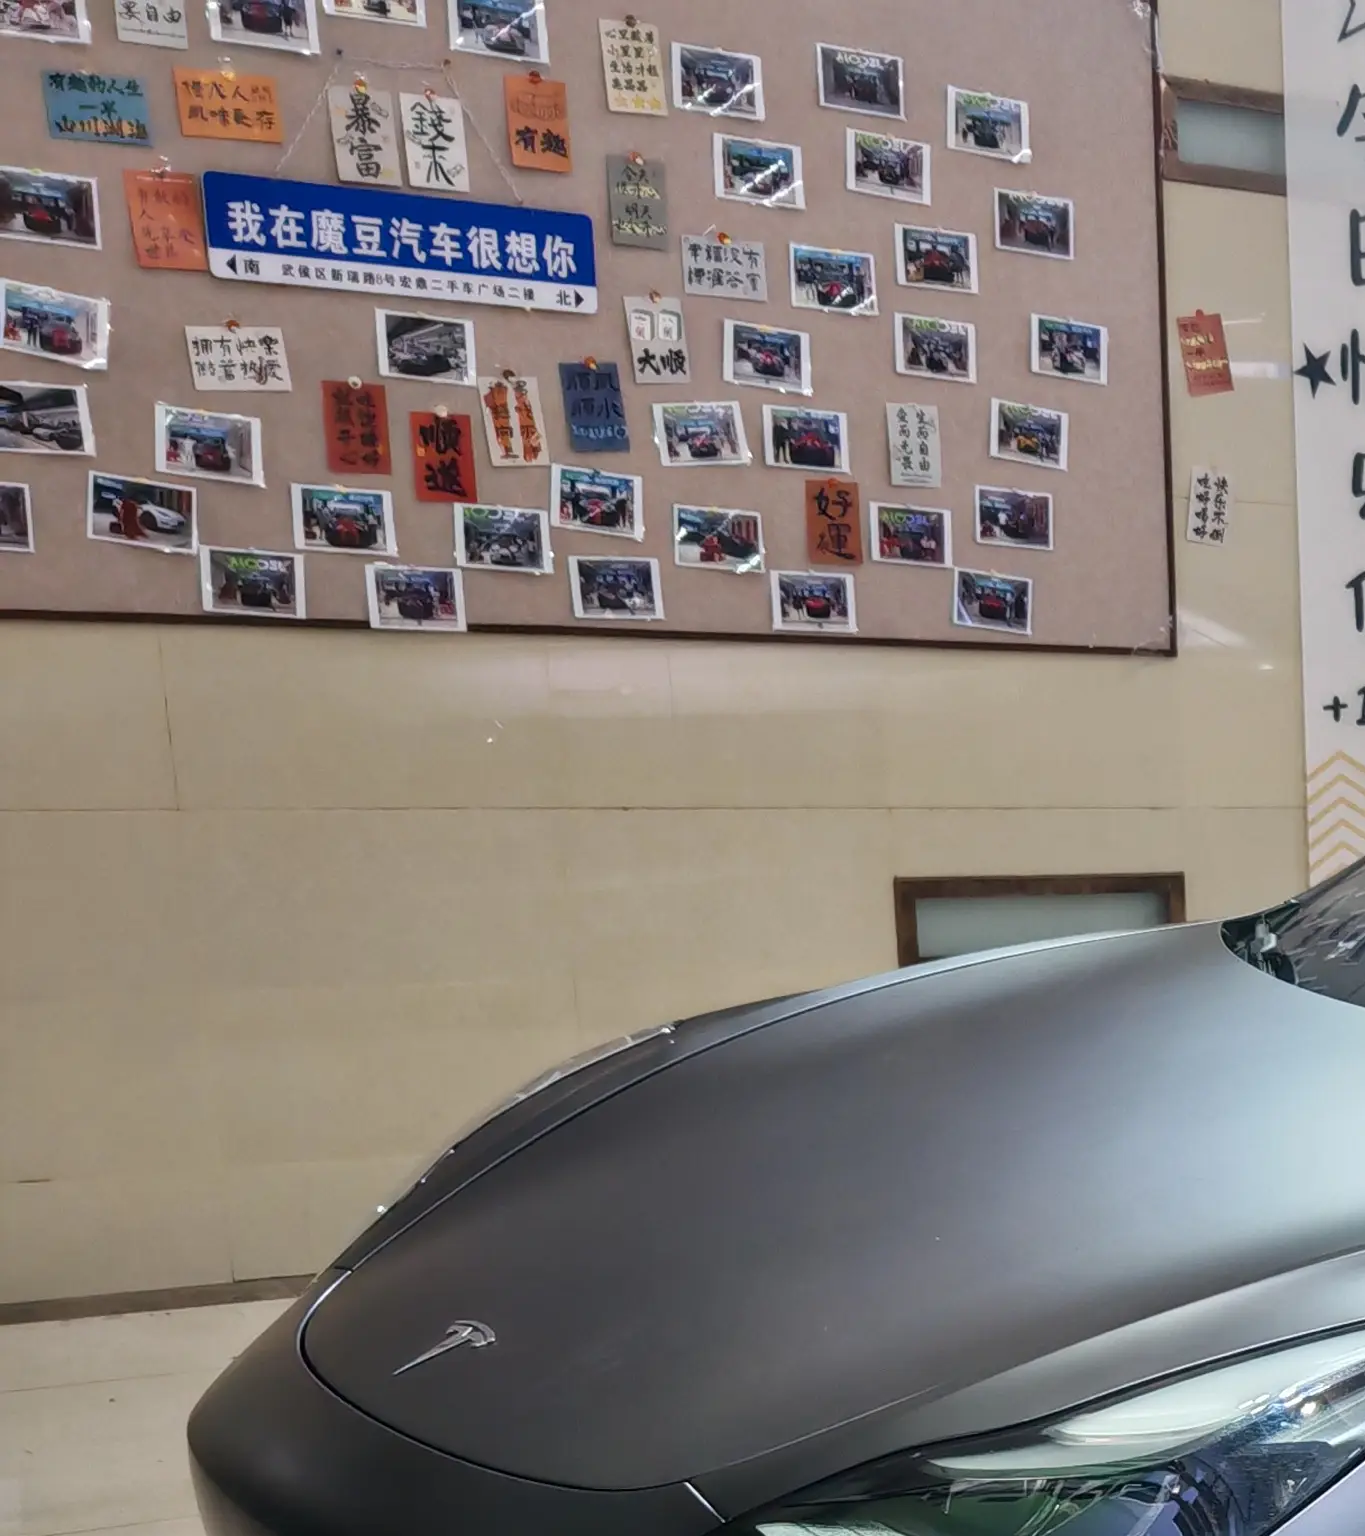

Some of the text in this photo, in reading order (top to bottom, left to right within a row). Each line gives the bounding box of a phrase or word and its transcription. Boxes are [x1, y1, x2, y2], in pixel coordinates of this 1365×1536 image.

[345, 92, 382, 179] 暴富
[226, 200, 578, 279] 我在魔豆汽车很想你
[243, 257, 261, 277] 南
[556, 289, 572, 306] 北
